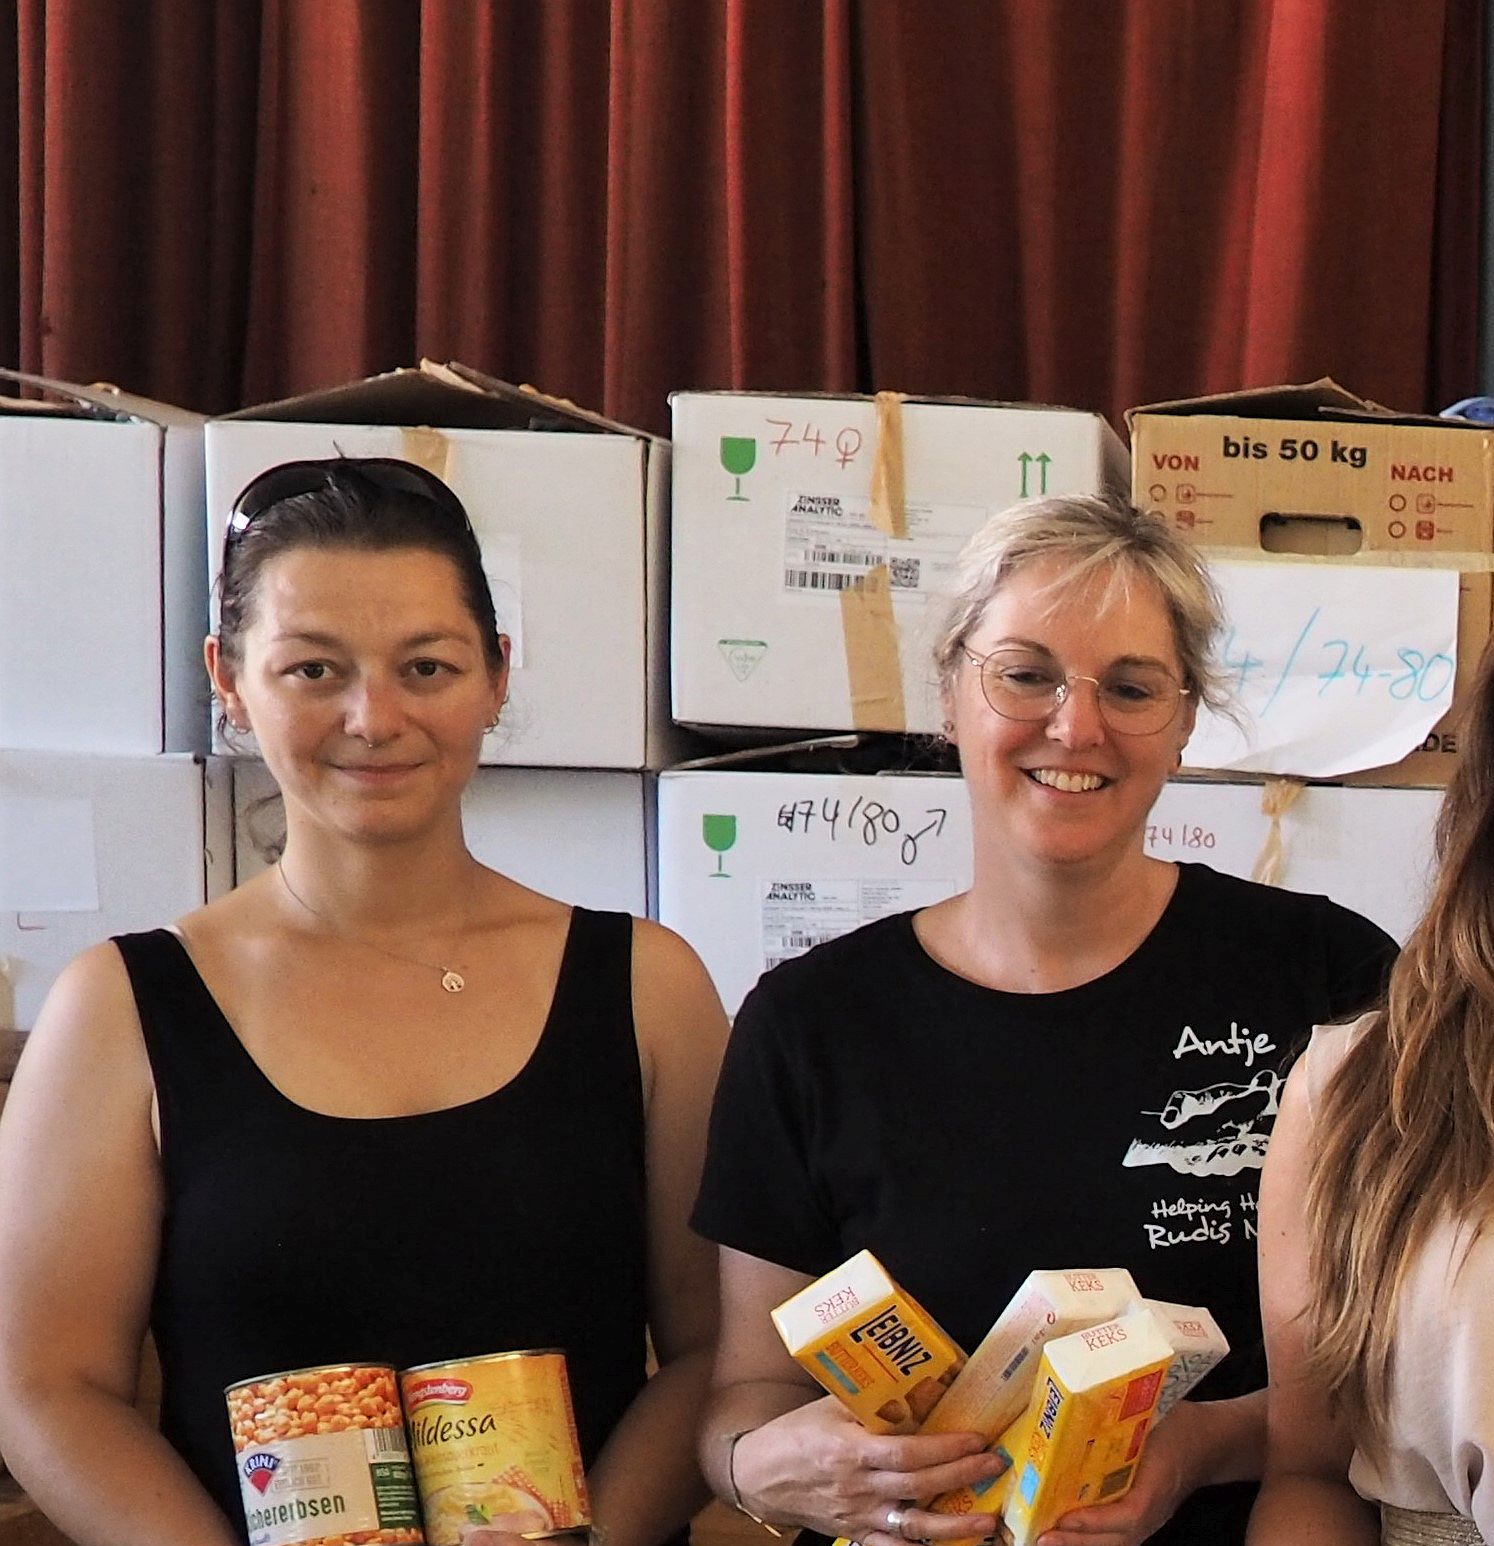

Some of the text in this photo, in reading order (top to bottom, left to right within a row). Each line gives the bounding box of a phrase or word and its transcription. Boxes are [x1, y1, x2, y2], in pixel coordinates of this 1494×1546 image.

[765, 418, 826, 457] 74
[1152, 453, 1200, 472] VON
[1222, 436, 1368, 468] bis 50 kg
[1390, 464, 1454, 483] NACH
[790, 504, 843, 517] ANALYTIC
[798, 495, 840, 506] ZINSSER
[765, 891, 816, 901] ANALYTIC
[771, 882, 812, 892] ZINSSER
[1172, 1021, 1276, 1067] Antje
[1150, 1197, 1231, 1222] Helping
[1142, 1215, 1232, 1250] Rudis
[814, 1285, 857, 1318] KEKS
[850, 1304, 933, 1377] LEIBNIZ
[1085, 1328, 1128, 1352] KEKS
[1039, 1375, 1065, 1440] LEIBNIZ
